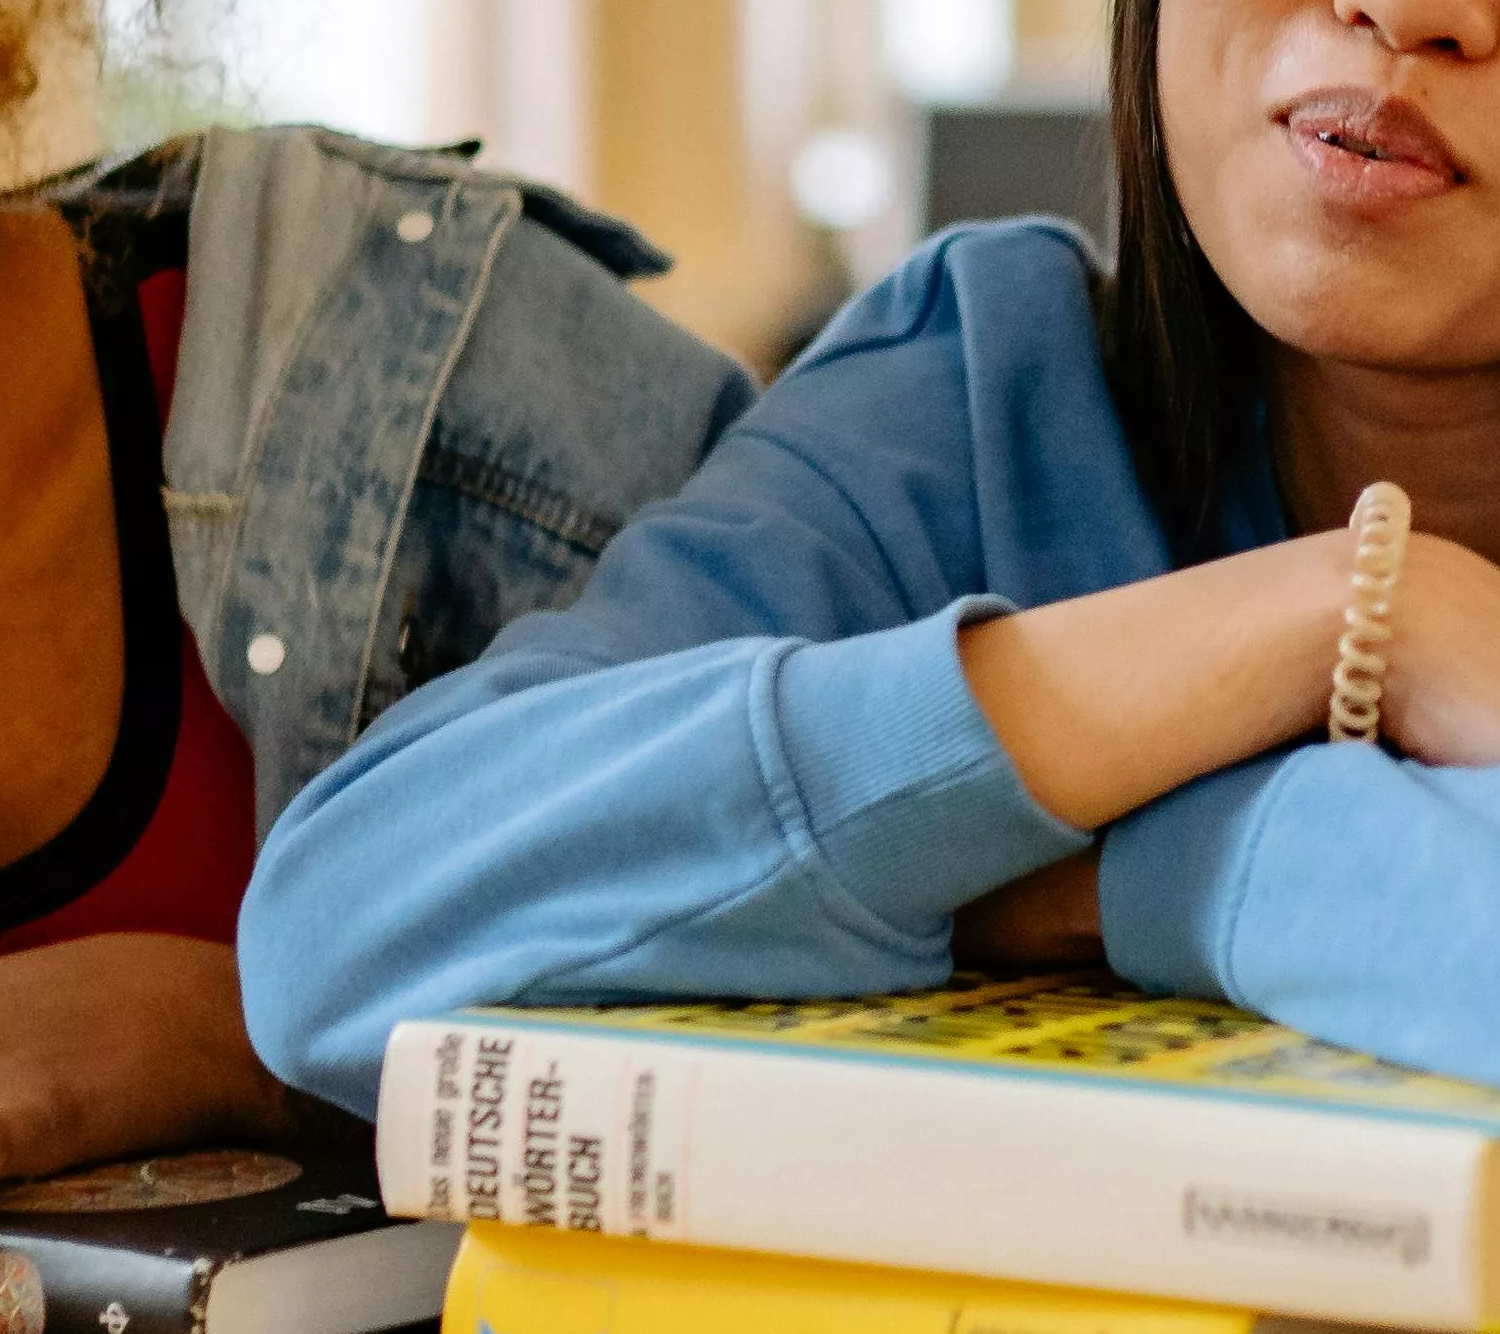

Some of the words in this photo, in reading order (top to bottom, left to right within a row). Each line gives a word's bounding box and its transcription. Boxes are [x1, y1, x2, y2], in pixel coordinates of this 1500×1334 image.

[467, 1037, 514, 1218] DEUTSCHE
[513, 1059, 563, 1225] WÖRTER-
[567, 1136, 605, 1231] BUCH
